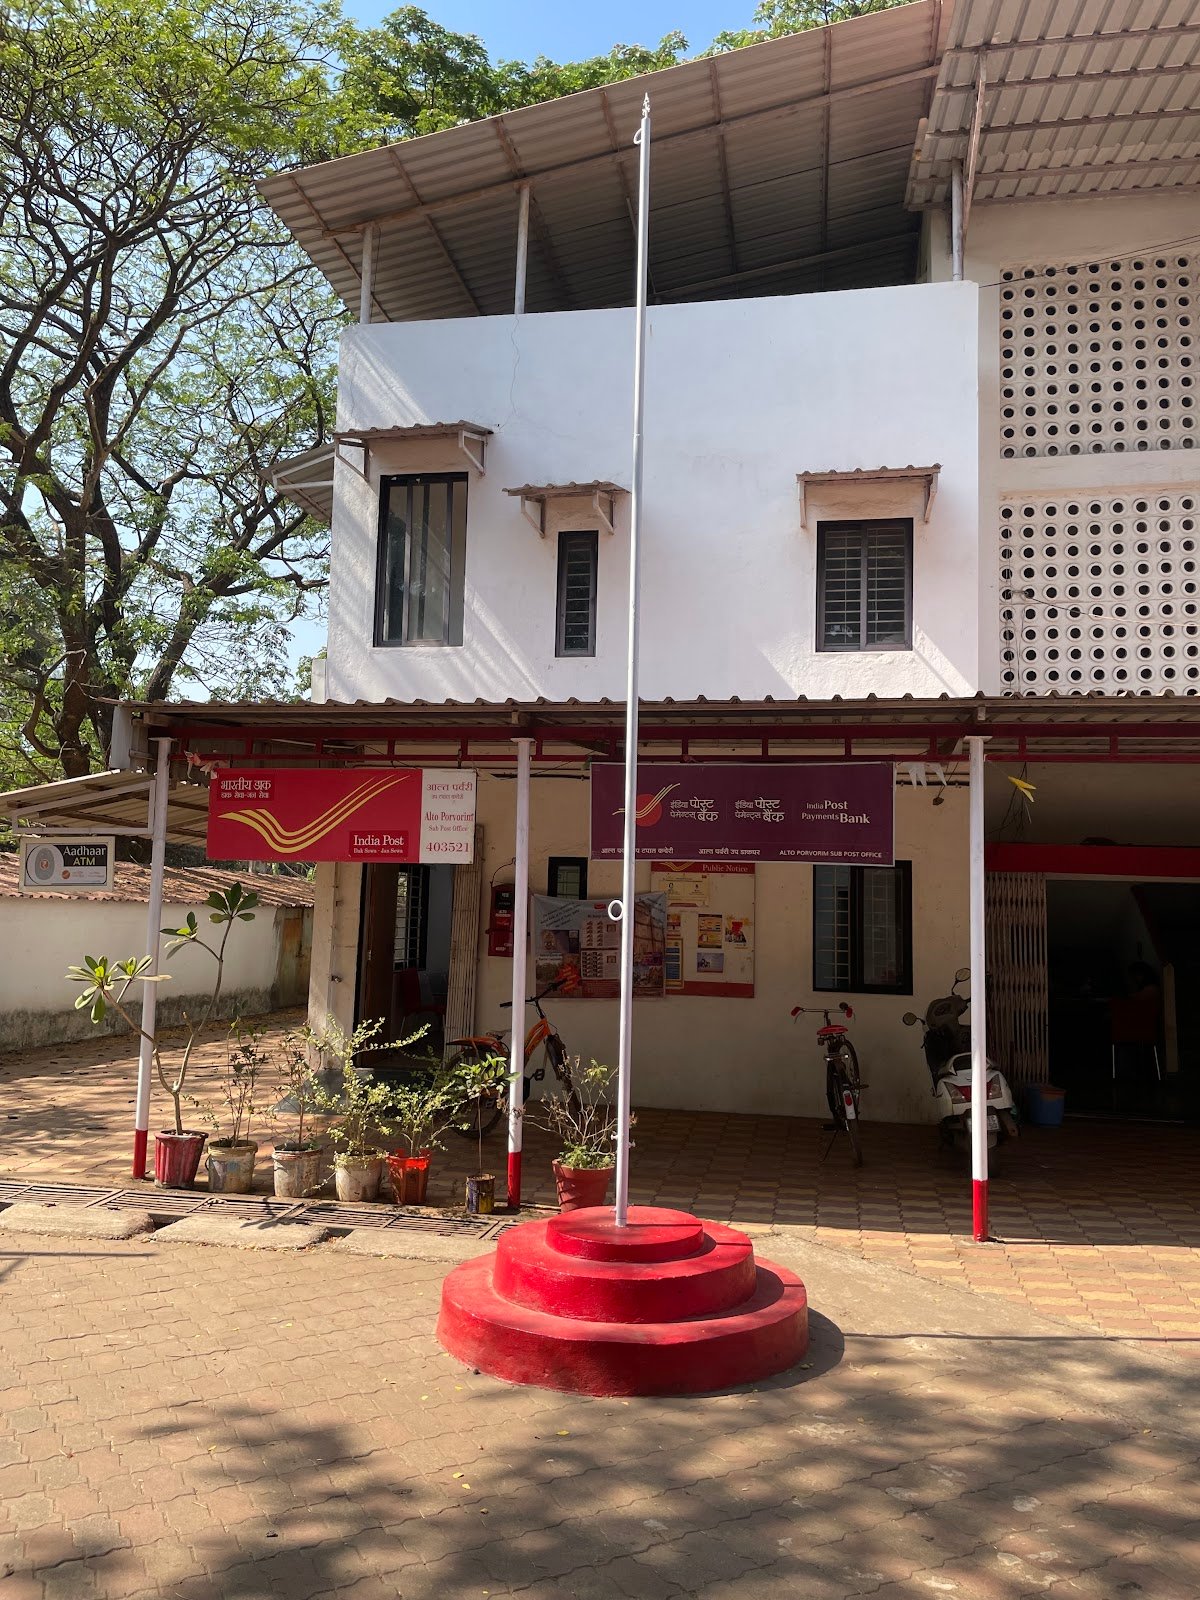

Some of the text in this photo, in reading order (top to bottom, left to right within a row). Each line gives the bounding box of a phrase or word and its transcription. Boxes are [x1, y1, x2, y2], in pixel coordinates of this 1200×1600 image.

[220, 776, 272, 791] भारतीय डाक
[452, 781, 473, 791] पर्वरी
[221, 791, 232, 799] डाक
[670, 796, 714, 809] इंडिया पोस्ट
[734, 797, 781, 809] इंडिया पोस्ट
[824, 799, 848, 810] Post
[425, 811, 439, 821] Alto
[762, 808, 785, 822] बैंक
[801, 812, 871, 824] Payments Bank
[428, 824, 468, 832] Sub Post Office
[353, 834, 405, 846] India Post
[63, 846, 106, 856] Aadhaar
[425, 842, 470, 853] 403521
[73, 857, 95, 865] ATM
[702, 863, 748, 872] Public Notice
